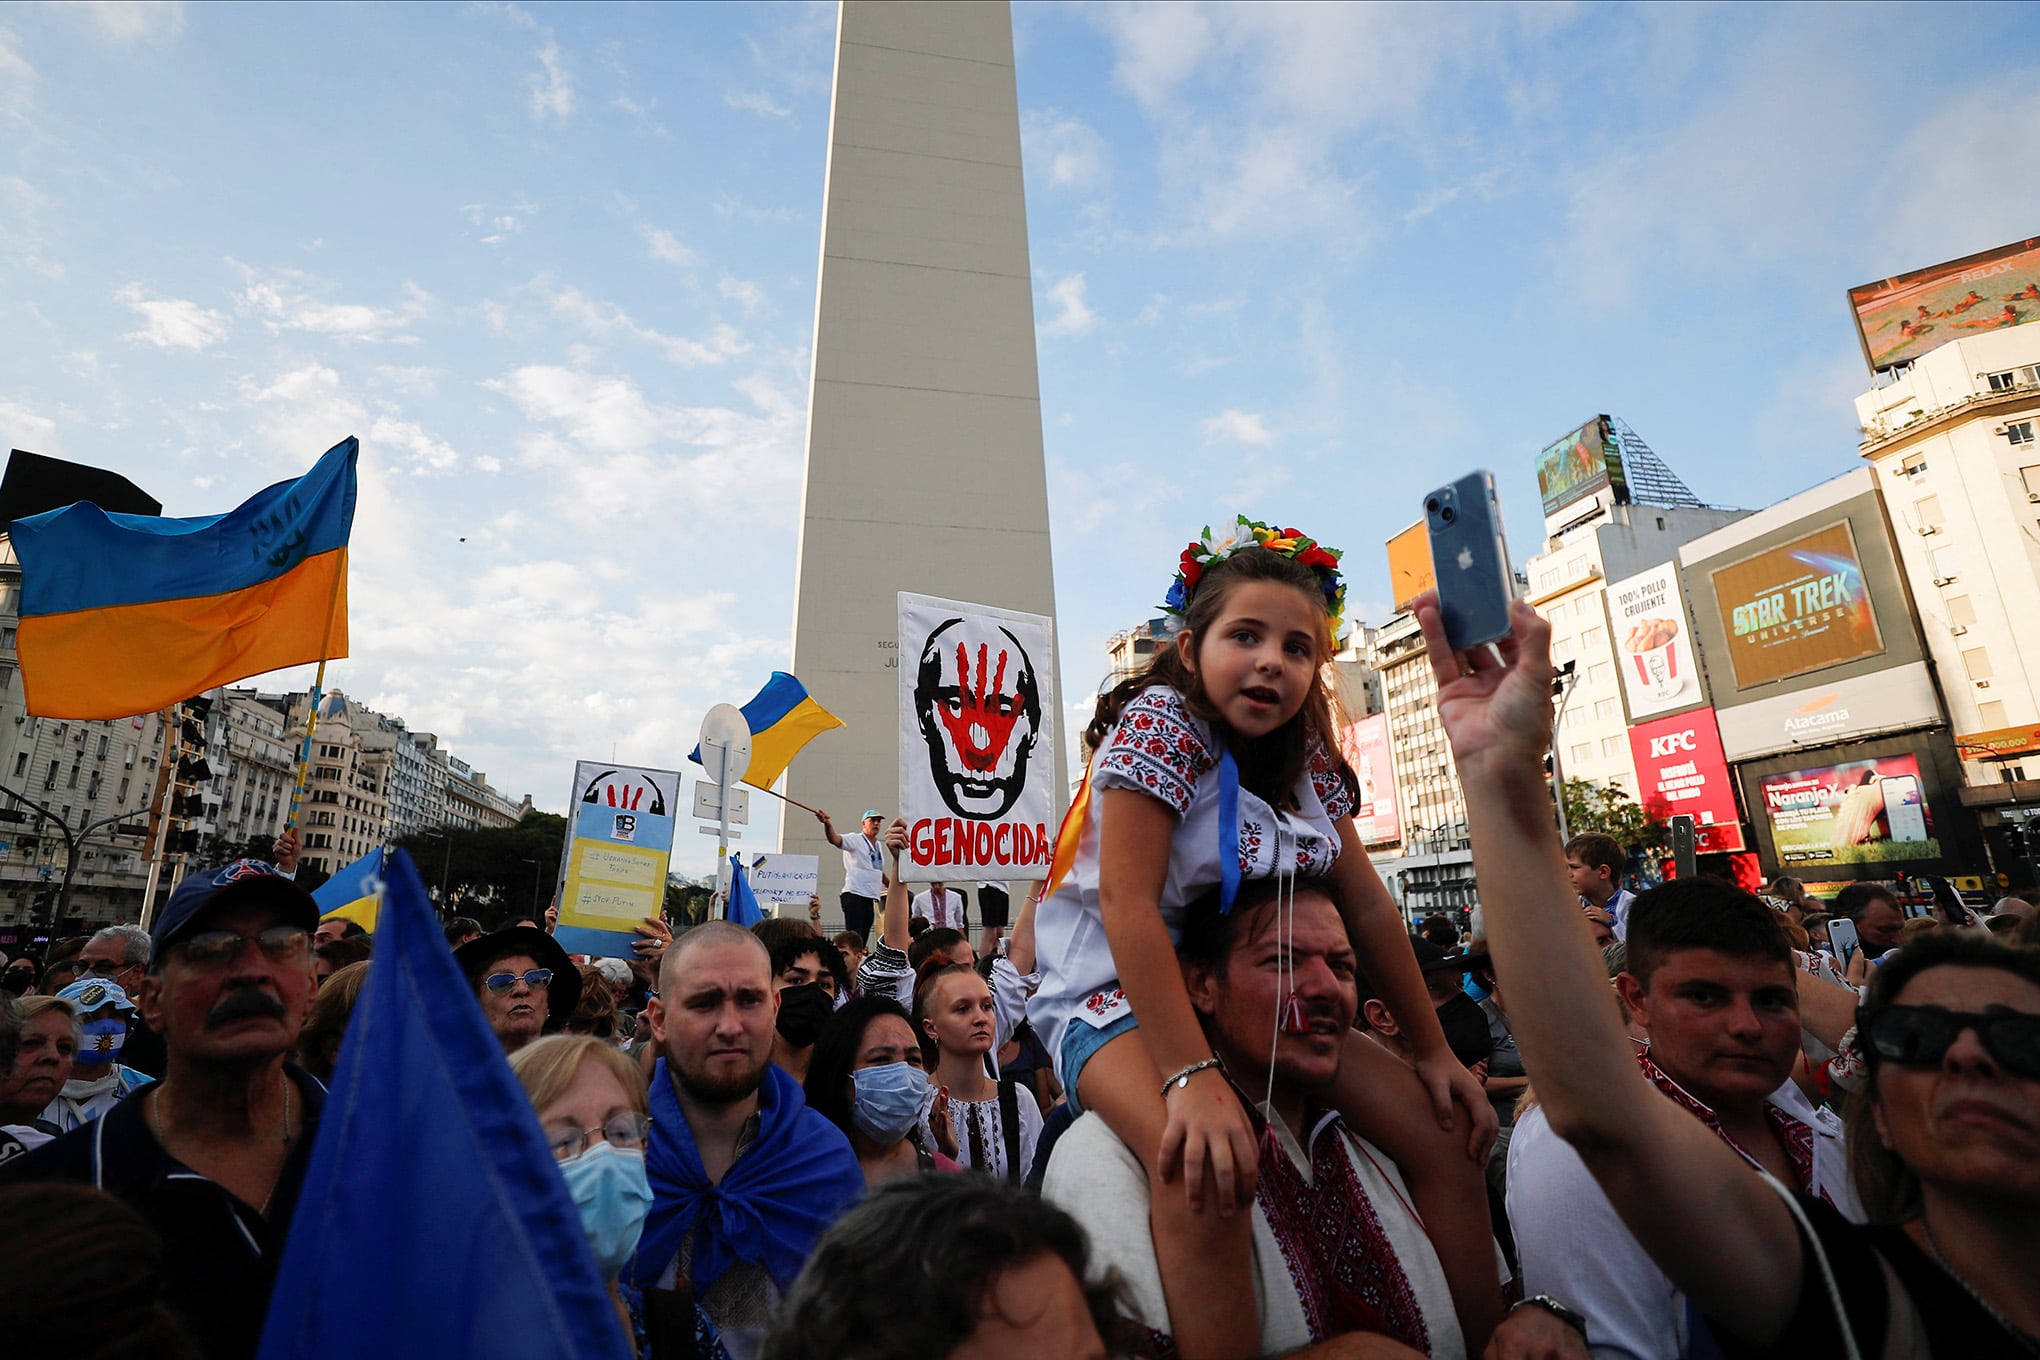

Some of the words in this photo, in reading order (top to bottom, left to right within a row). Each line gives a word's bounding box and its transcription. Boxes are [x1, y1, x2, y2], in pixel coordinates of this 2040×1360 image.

[1959, 262, 2015, 284] RELAX
[1618, 588, 1640, 606] 100%
[1641, 578, 1667, 597] POLLO
[1624, 594, 1667, 618] CRUJIENTE
[1732, 592, 1787, 637] STAR
[1790, 570, 1852, 617] TREK
[1747, 607, 1846, 644] UNIVERSE
[1784, 708, 1850, 731] Atacama
[1650, 729, 1697, 759] KFC
[910, 817, 1051, 867] GENOCIDA
